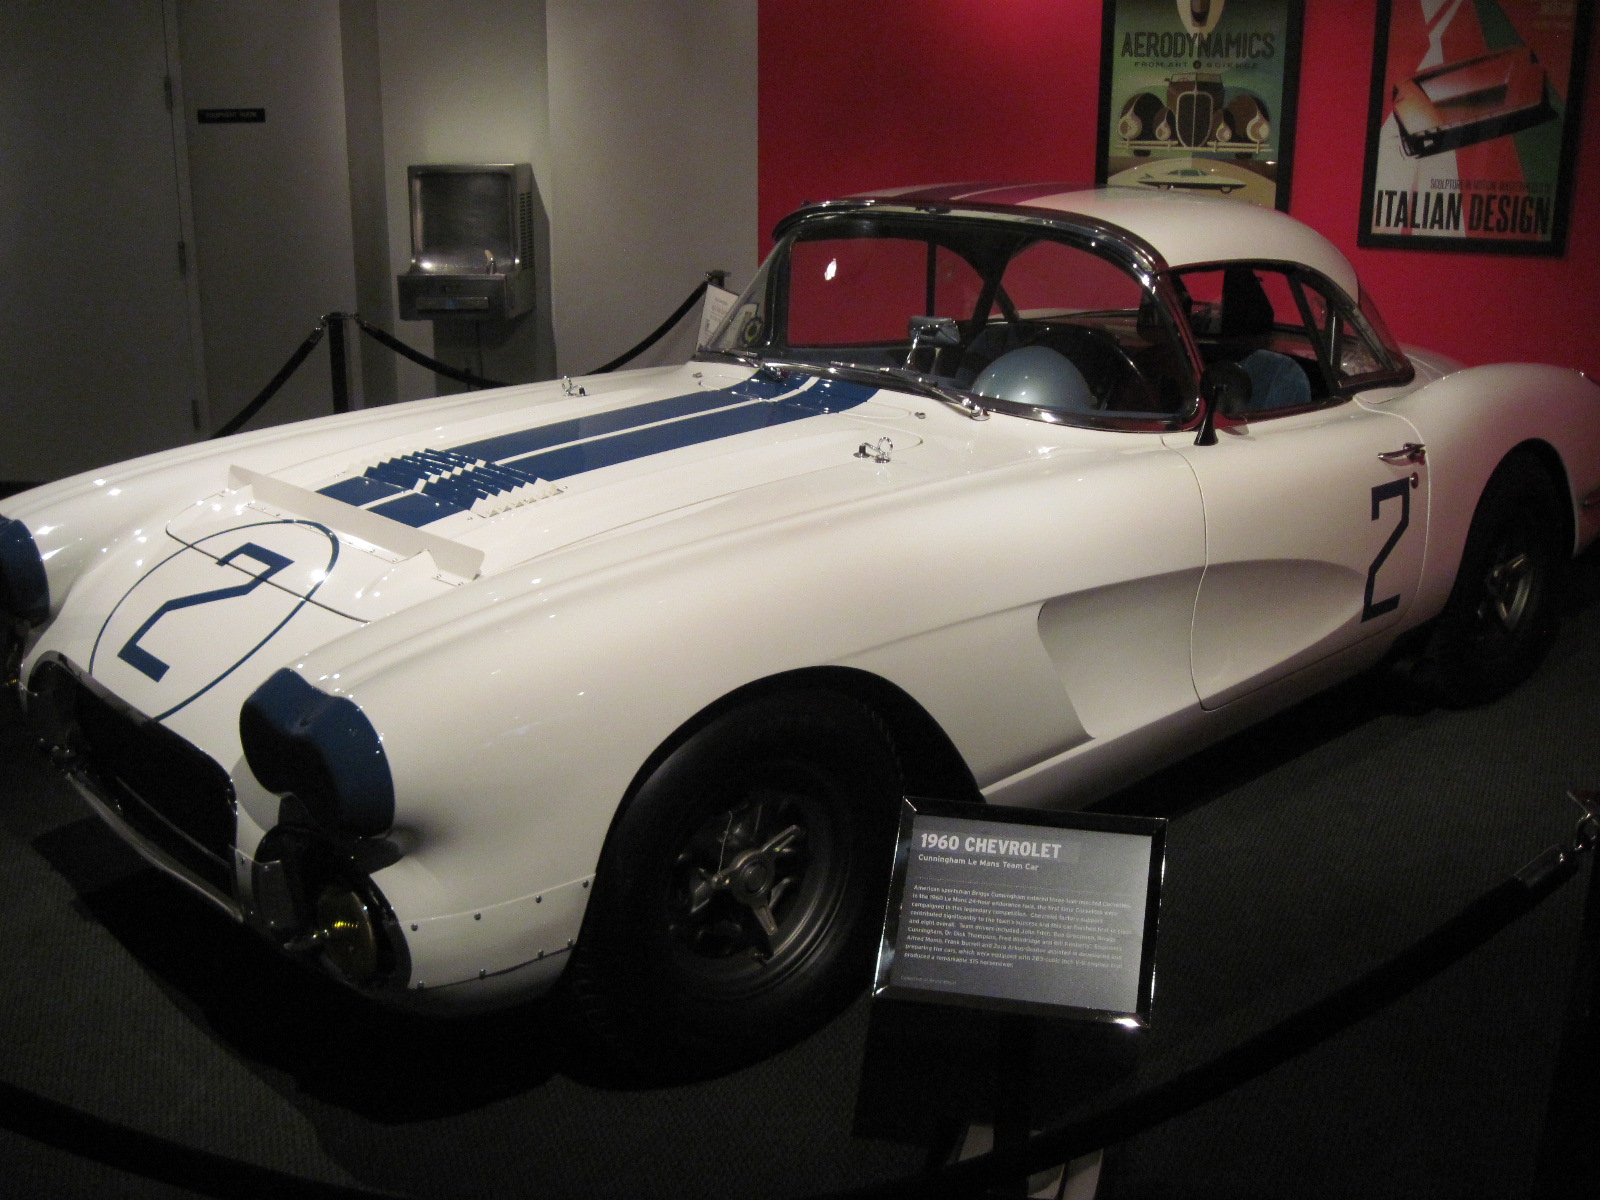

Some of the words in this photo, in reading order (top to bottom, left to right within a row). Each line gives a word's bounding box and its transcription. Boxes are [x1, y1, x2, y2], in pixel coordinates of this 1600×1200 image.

[1121, 32, 1275, 59] AERODYNAMICS
[1134, 61, 1163, 69] FROM
[1167, 61, 1188, 69] ART
[1205, 62, 1258, 70] SCIENCE
[1430, 178, 1464, 190] SCULPTURE
[1375, 190, 1463, 231] ITALIAN
[1468, 193, 1552, 235] DESIGN
[1361, 476, 1410, 623] 2
[117, 541, 295, 683] 2
[920, 833, 960, 850] 1960
[964, 837, 1062, 859] CHEVROLET
[918, 854, 966, 865] Cunningham
[967, 857, 977, 865] Le
[979, 858, 1000, 867] Mans
[1002, 861, 1023, 869] Team
[1024, 862, 1039, 870] Car
[941, 887, 970, 895] sportsman
[971, 889, 989, 897] Briggs
[990, 891, 1025, 900] Cunningham
[911, 901, 944, 910] campaigned
[963, 906, 991, 914] legendary
[992, 908, 1027, 917] competition.
[1058, 914, 1079, 922] factory
[1080, 916, 1102, 924] support
[1075, 907, 1102, 915] Corvettes
[907, 926, 943, 935] Cunningham,
[966, 931, 997, 940] Thompson,
[920, 918, 935, 926] eight
[995, 925, 1019, 933] included
[904, 952, 930, 960] produced
[935, 955, 967, 963] remarkable
[979, 959, 1014, 969] horsepower.
